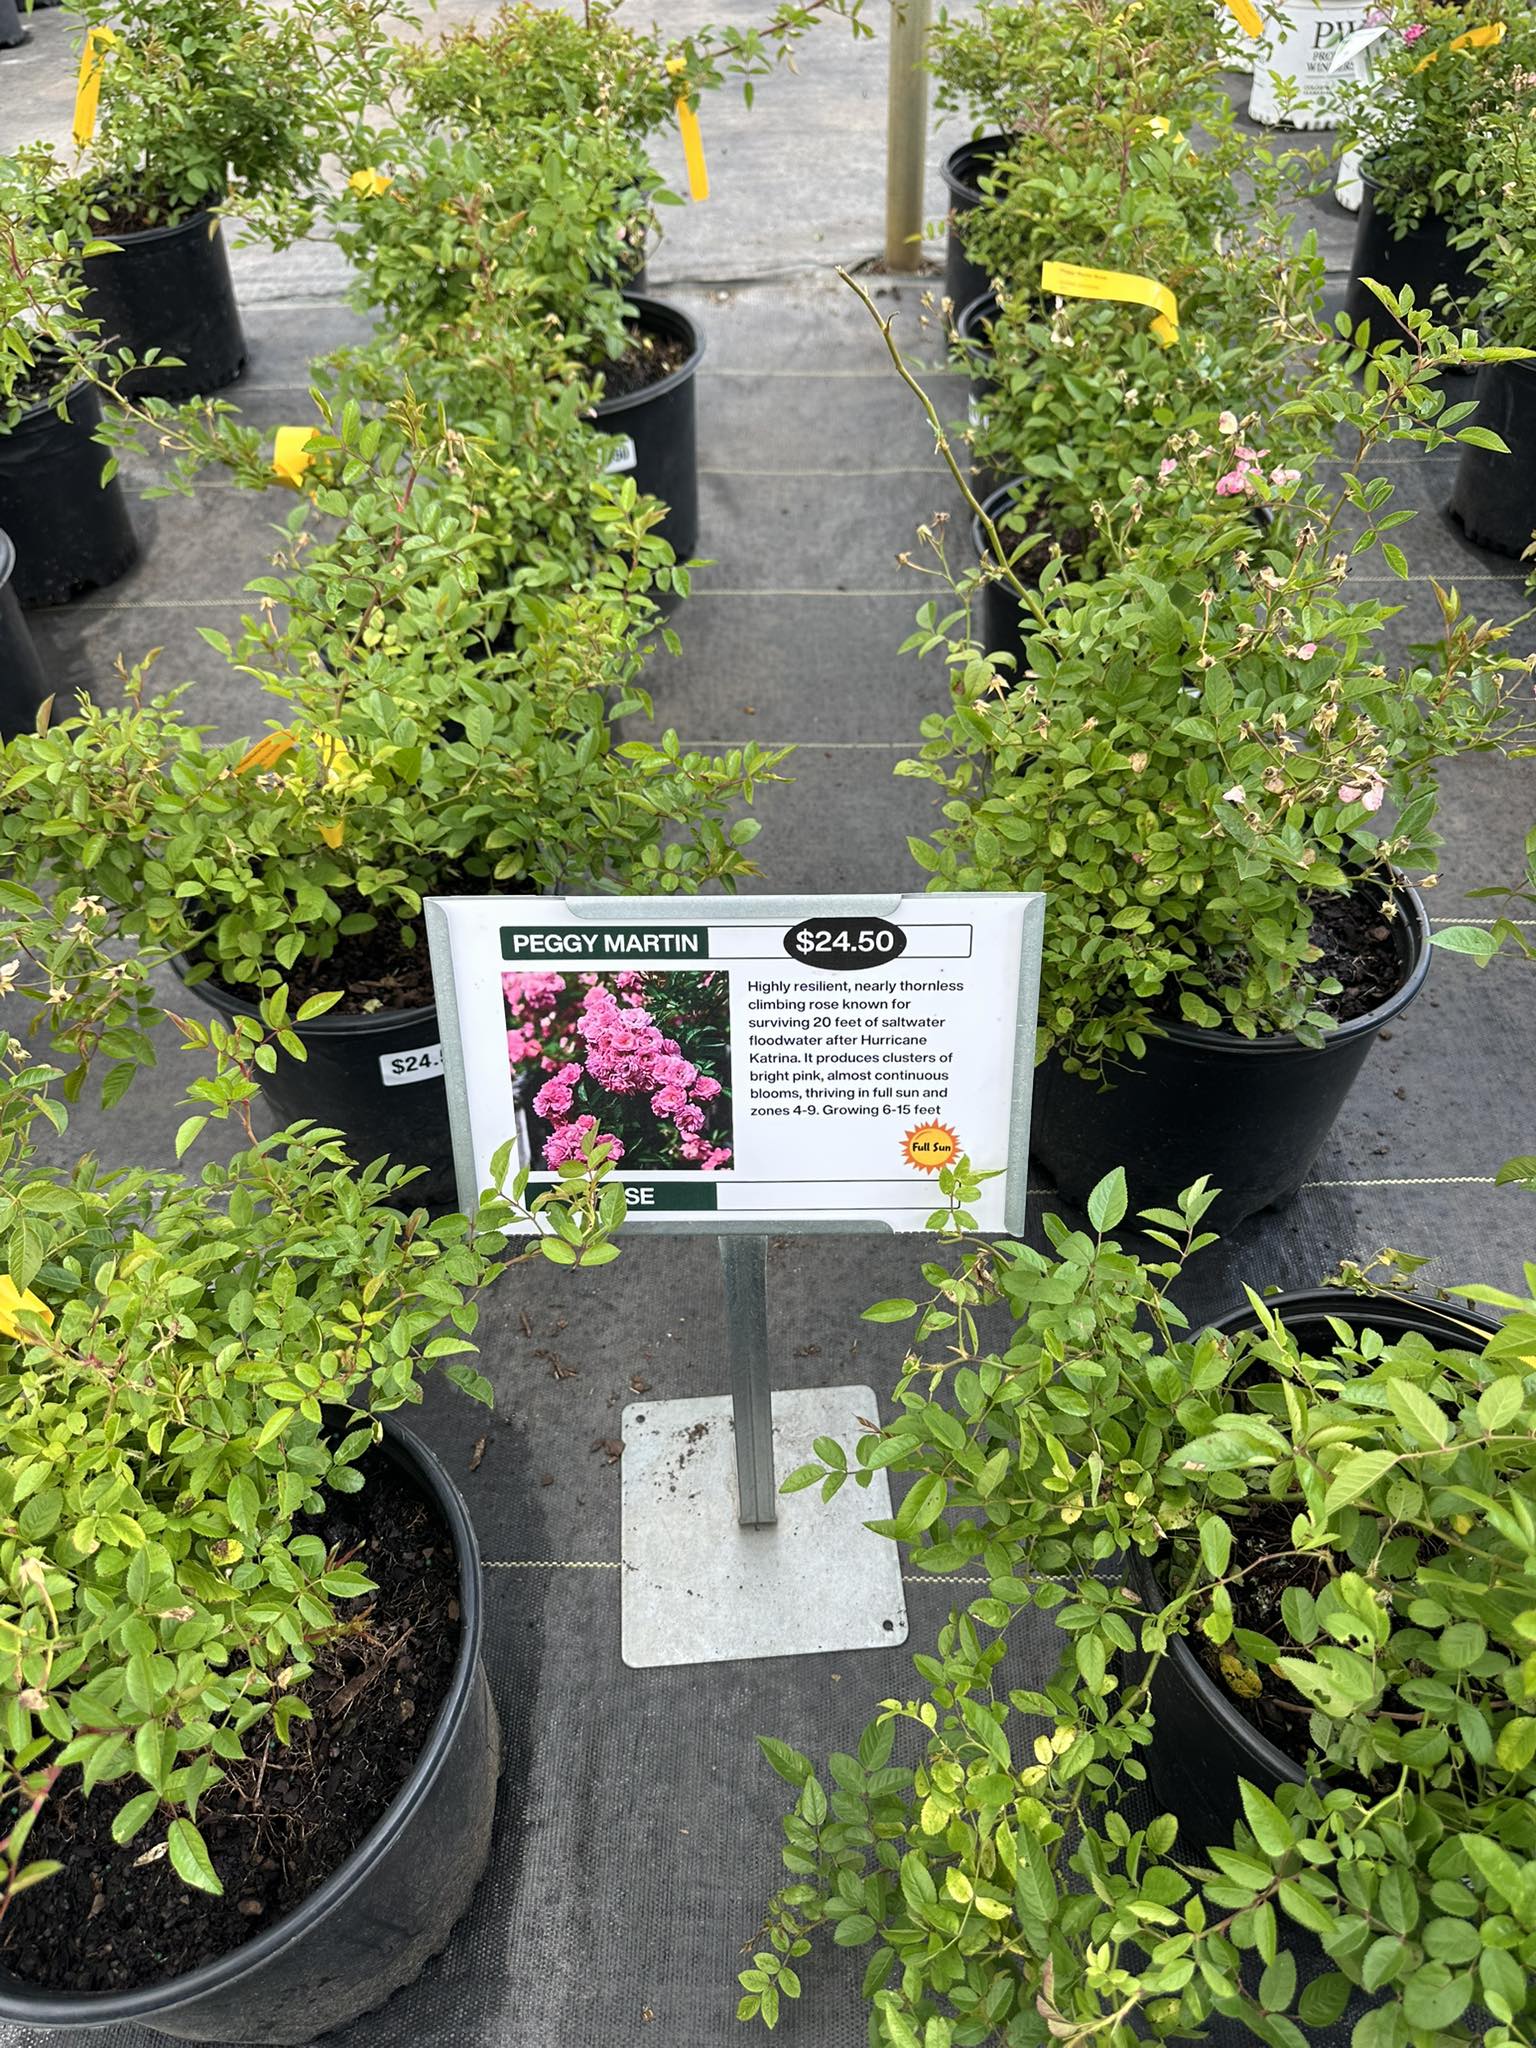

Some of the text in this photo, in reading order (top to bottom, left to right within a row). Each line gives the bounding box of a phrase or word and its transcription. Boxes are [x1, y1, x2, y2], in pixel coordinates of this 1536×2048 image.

[512, 933, 699, 953] PEGGY MARTIN
[795, 928, 895, 955] $24.50
[747, 979, 965, 995] Highly resilient, nearly thornless
[747, 998, 912, 1013] climbing rose known for
[748, 1016, 946, 1031] surviving 20 feet of saltwater
[748, 1034, 928, 1046] floodwater after Hurricane
[391, 1050, 444, 1075] $24.
[749, 1052, 954, 1066] Katrina. It produces clusters of
[749, 1069, 950, 1084] bright pink, almost continuous
[750, 1086, 948, 1101] blooms, thriving in full sun and
[750, 1103, 941, 1118] zones 4-9. Growing 6-15 feet
[912, 1142, 951, 1152] Full Sun
